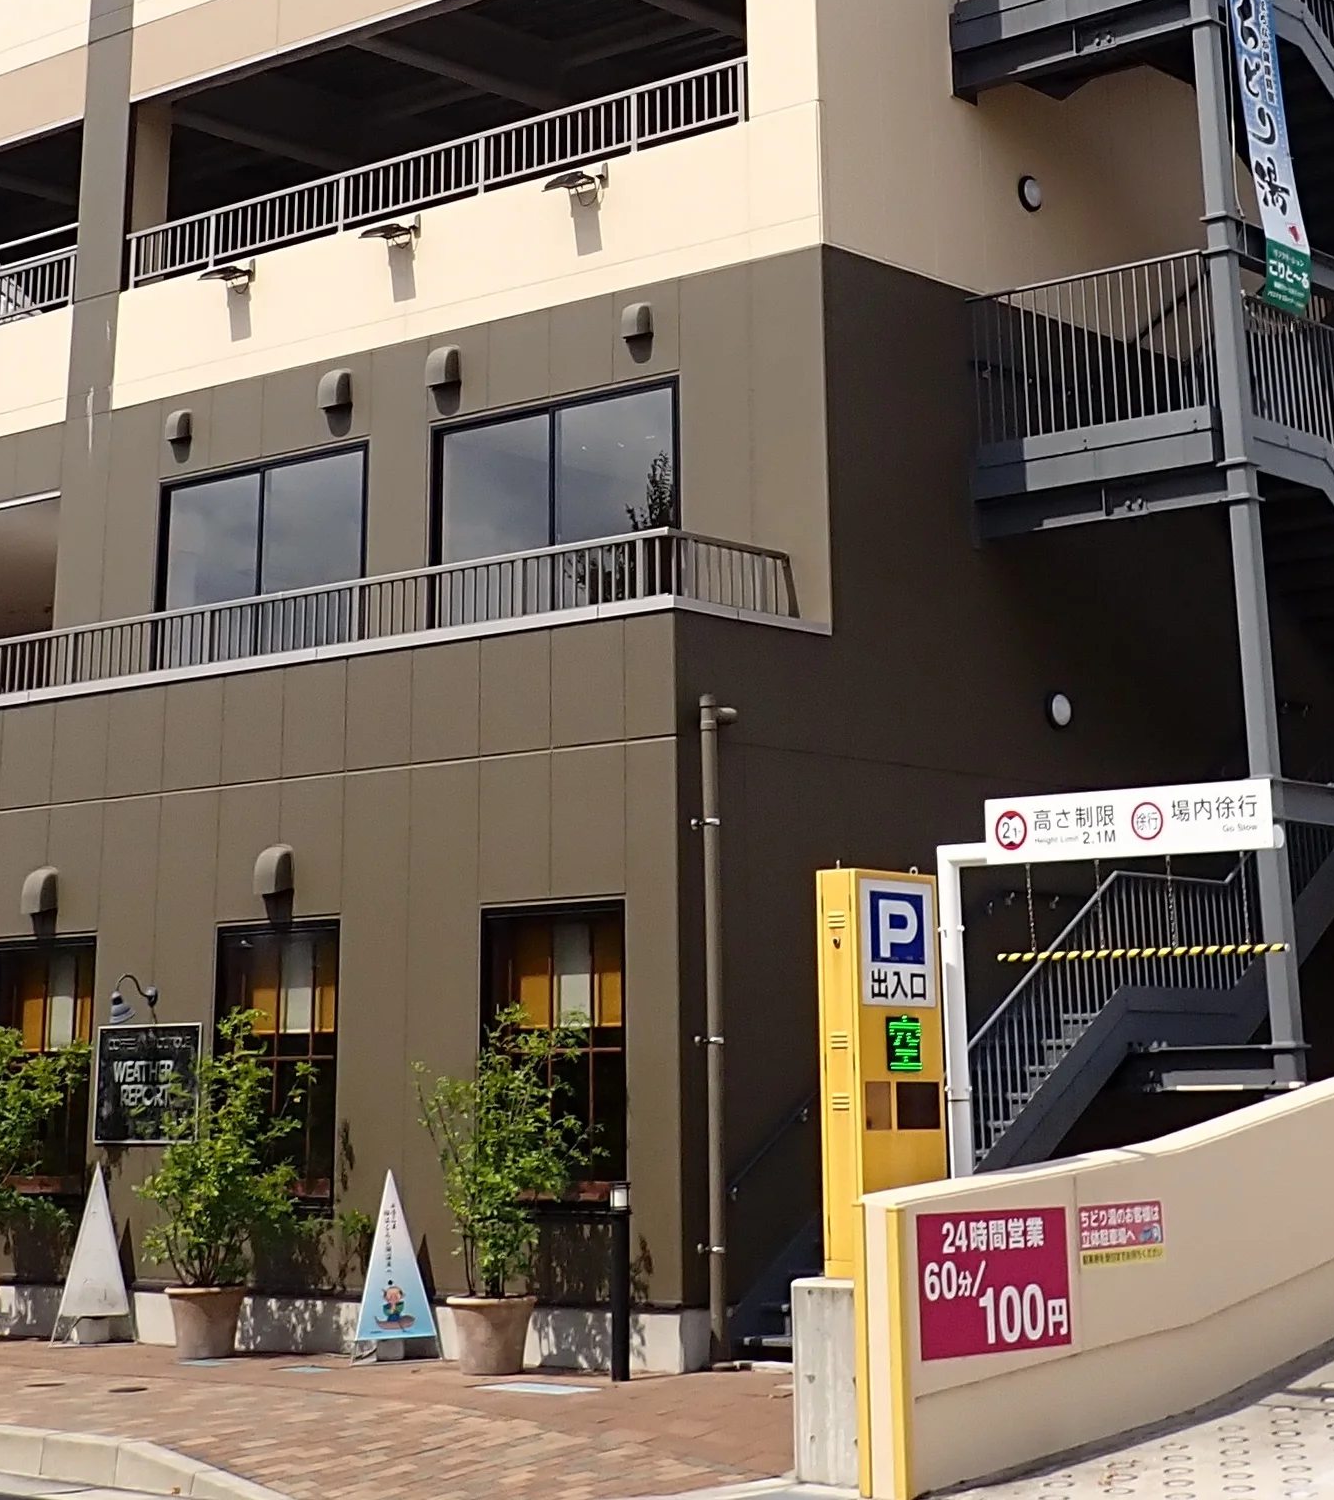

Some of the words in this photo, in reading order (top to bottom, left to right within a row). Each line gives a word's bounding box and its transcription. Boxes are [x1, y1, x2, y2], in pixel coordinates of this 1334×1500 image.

[1033, 804, 1115, 831] 高さ制限
[1136, 811, 1158, 831] 徐行
[1171, 794, 1258, 822] 場内徐行
[1082, 829, 1116, 845] 2.1M
[1222, 823, 1235, 833] Go
[1237, 822, 1258, 832] Slow
[878, 899, 918, 958] P
[871, 968, 927, 1000] 出入口
[889, 1015, 923, 1070] 空
[113, 1060, 174, 1083] WEATHER
[120, 1083, 171, 1107] REPORT
[942, 1217, 1045, 1254] 24時間営業
[924, 1260, 986, 1301] 60分/
[979, 1284, 1068, 1344] 100円
